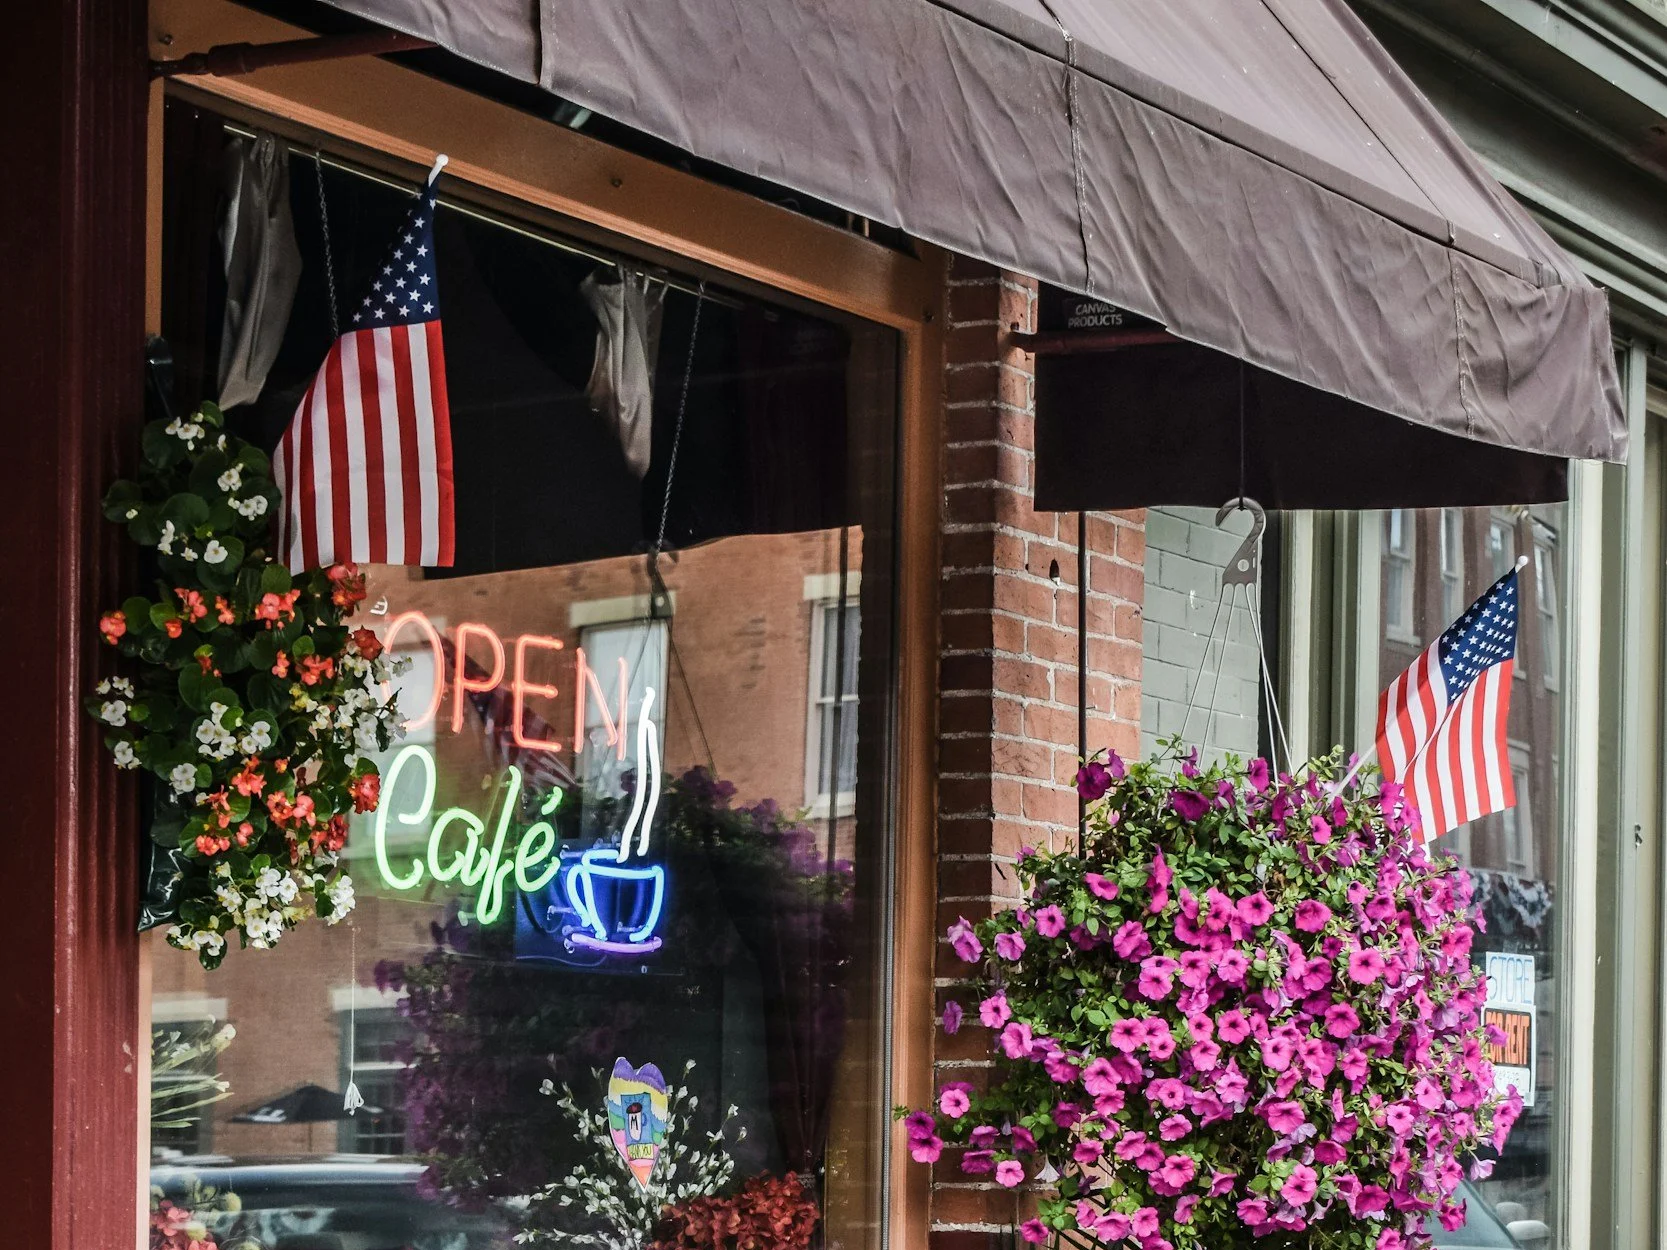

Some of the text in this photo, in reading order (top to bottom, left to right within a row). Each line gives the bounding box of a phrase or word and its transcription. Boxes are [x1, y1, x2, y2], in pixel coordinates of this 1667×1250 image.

[1068, 314, 1123, 329] PRODUCTS
[1075, 303, 1116, 316] CANVAS
[380, 610, 629, 762] OPEN
[374, 743, 562, 926] Café
[1490, 956, 1533, 1004] STORE
[1504, 1013, 1530, 1065] RENT
